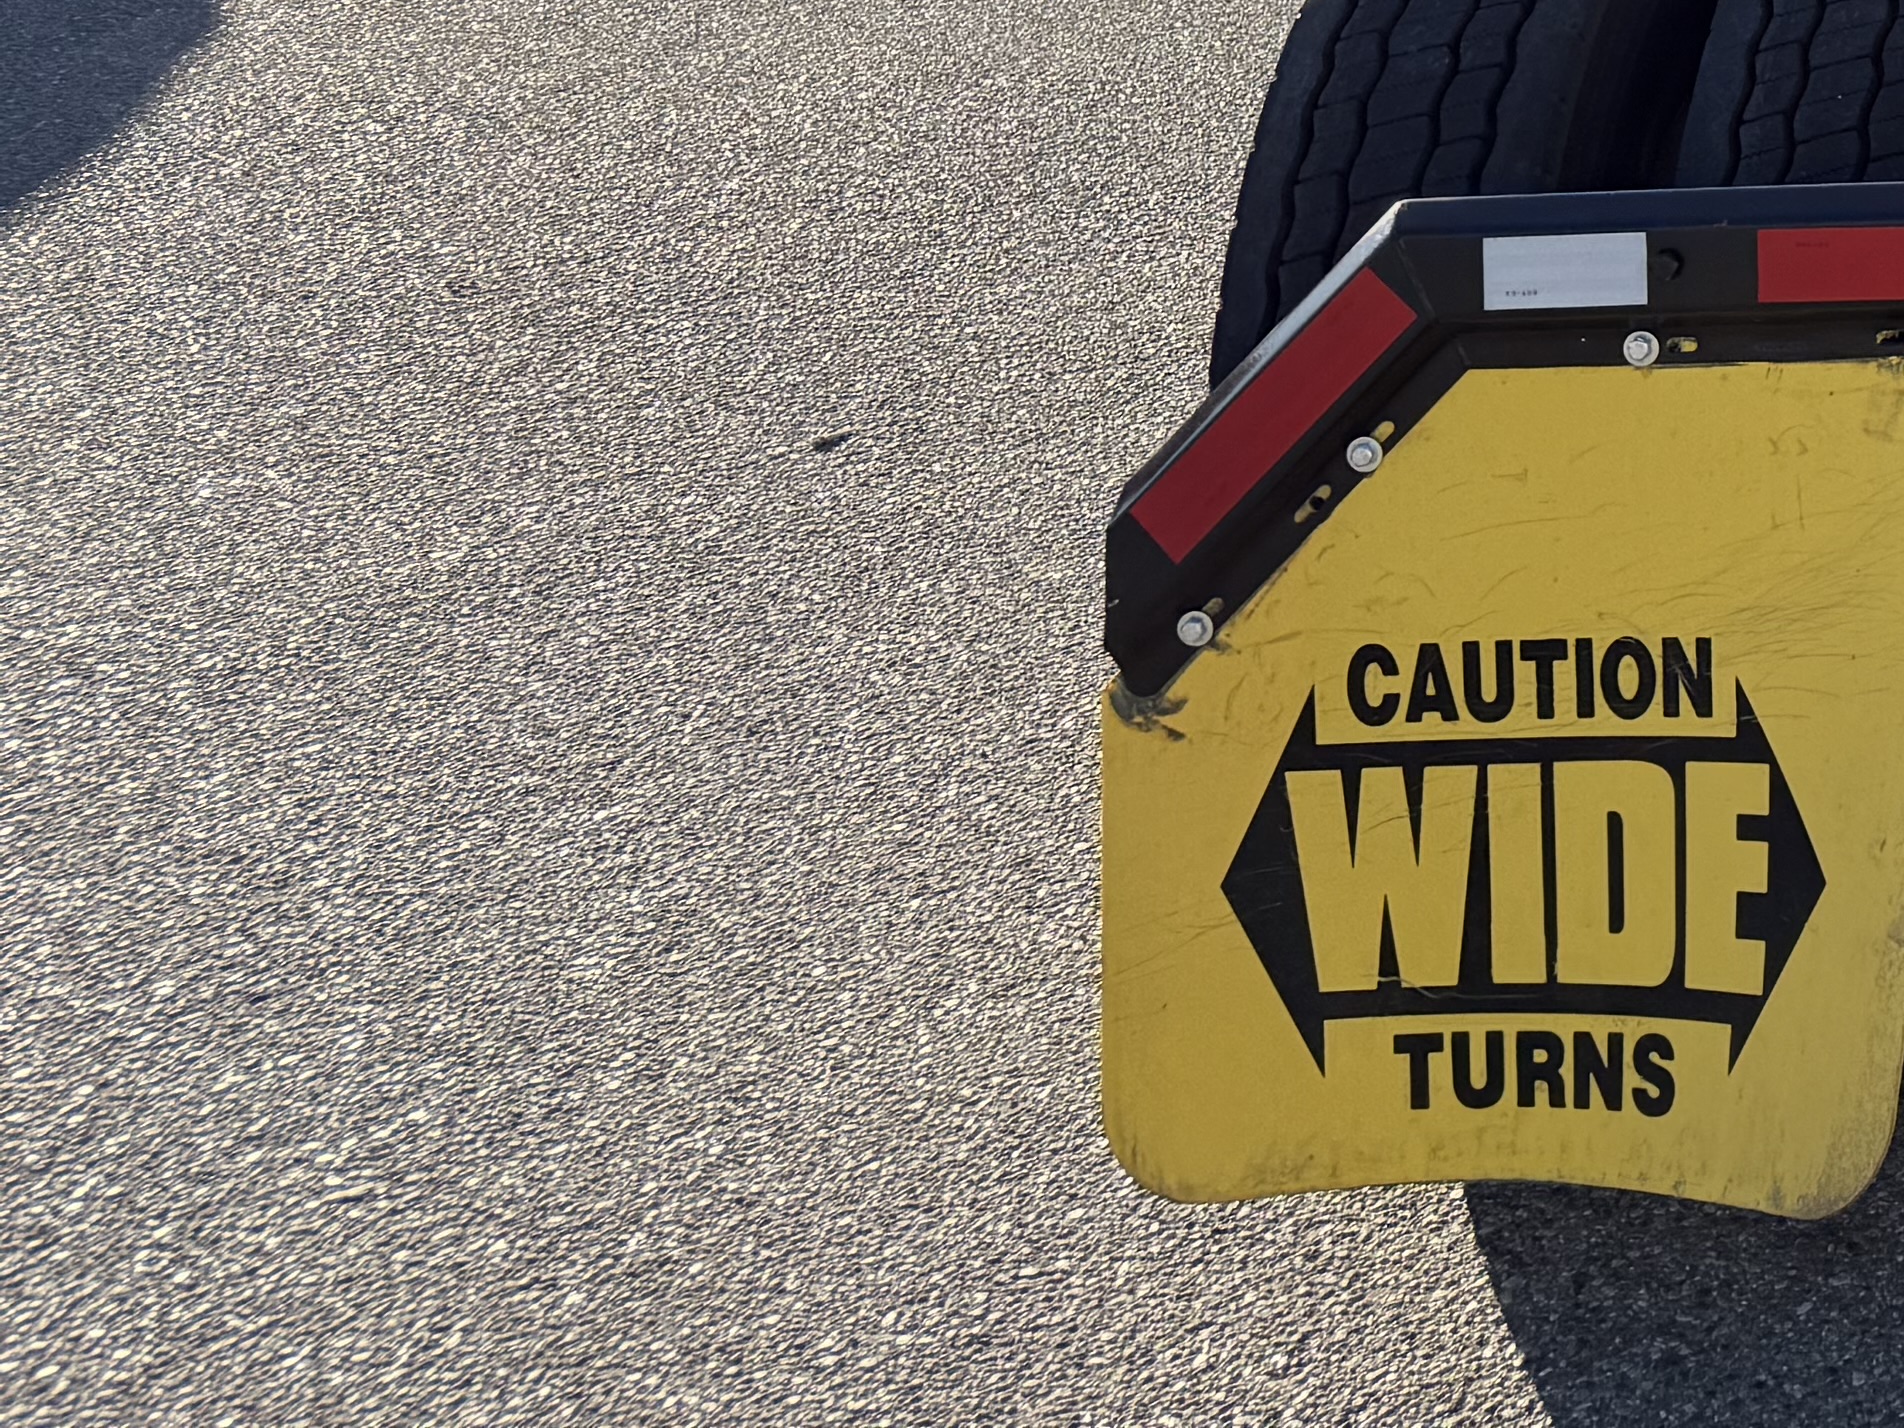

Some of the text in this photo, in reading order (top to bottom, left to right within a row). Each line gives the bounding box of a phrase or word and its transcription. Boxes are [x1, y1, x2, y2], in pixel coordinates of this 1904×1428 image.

[1345, 636, 1714, 728] CAUTION
[1283, 759, 1772, 997] WIDE
[1393, 1029, 1676, 1118] TURNS
